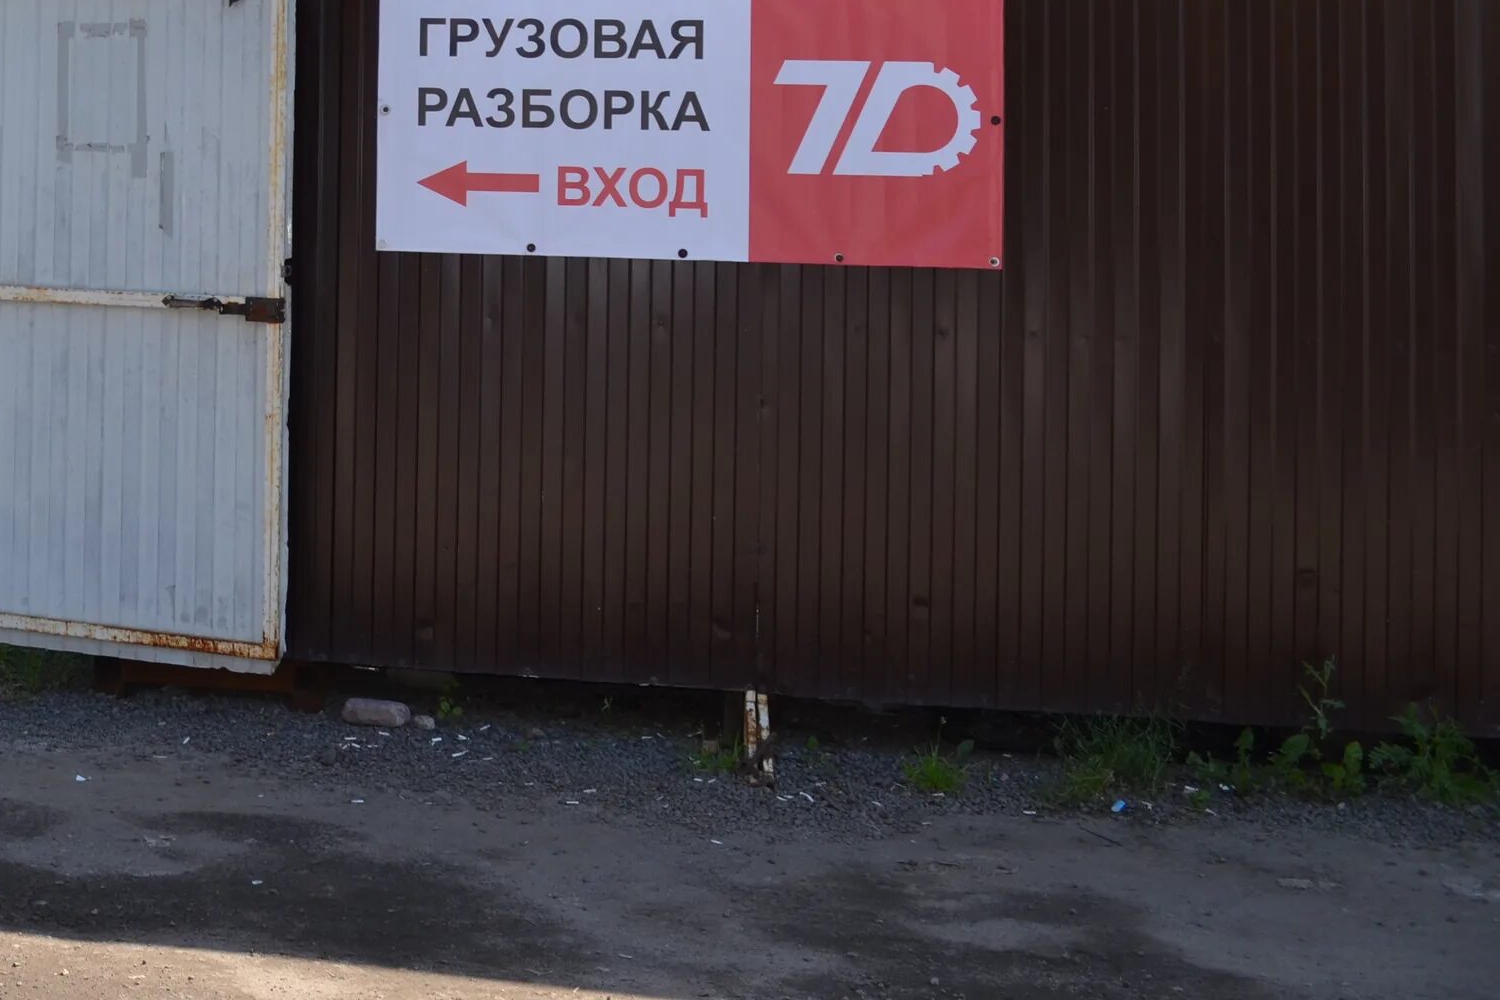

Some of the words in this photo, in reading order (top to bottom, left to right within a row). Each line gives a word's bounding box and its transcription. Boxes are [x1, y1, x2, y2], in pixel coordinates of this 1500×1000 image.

[419, 17, 704, 59] ГРУЗОВАЯ
[417, 87, 710, 131] РАЗБОРКА
[773, 59, 981, 177] 7D
[556, 166, 708, 218] ВХОД
